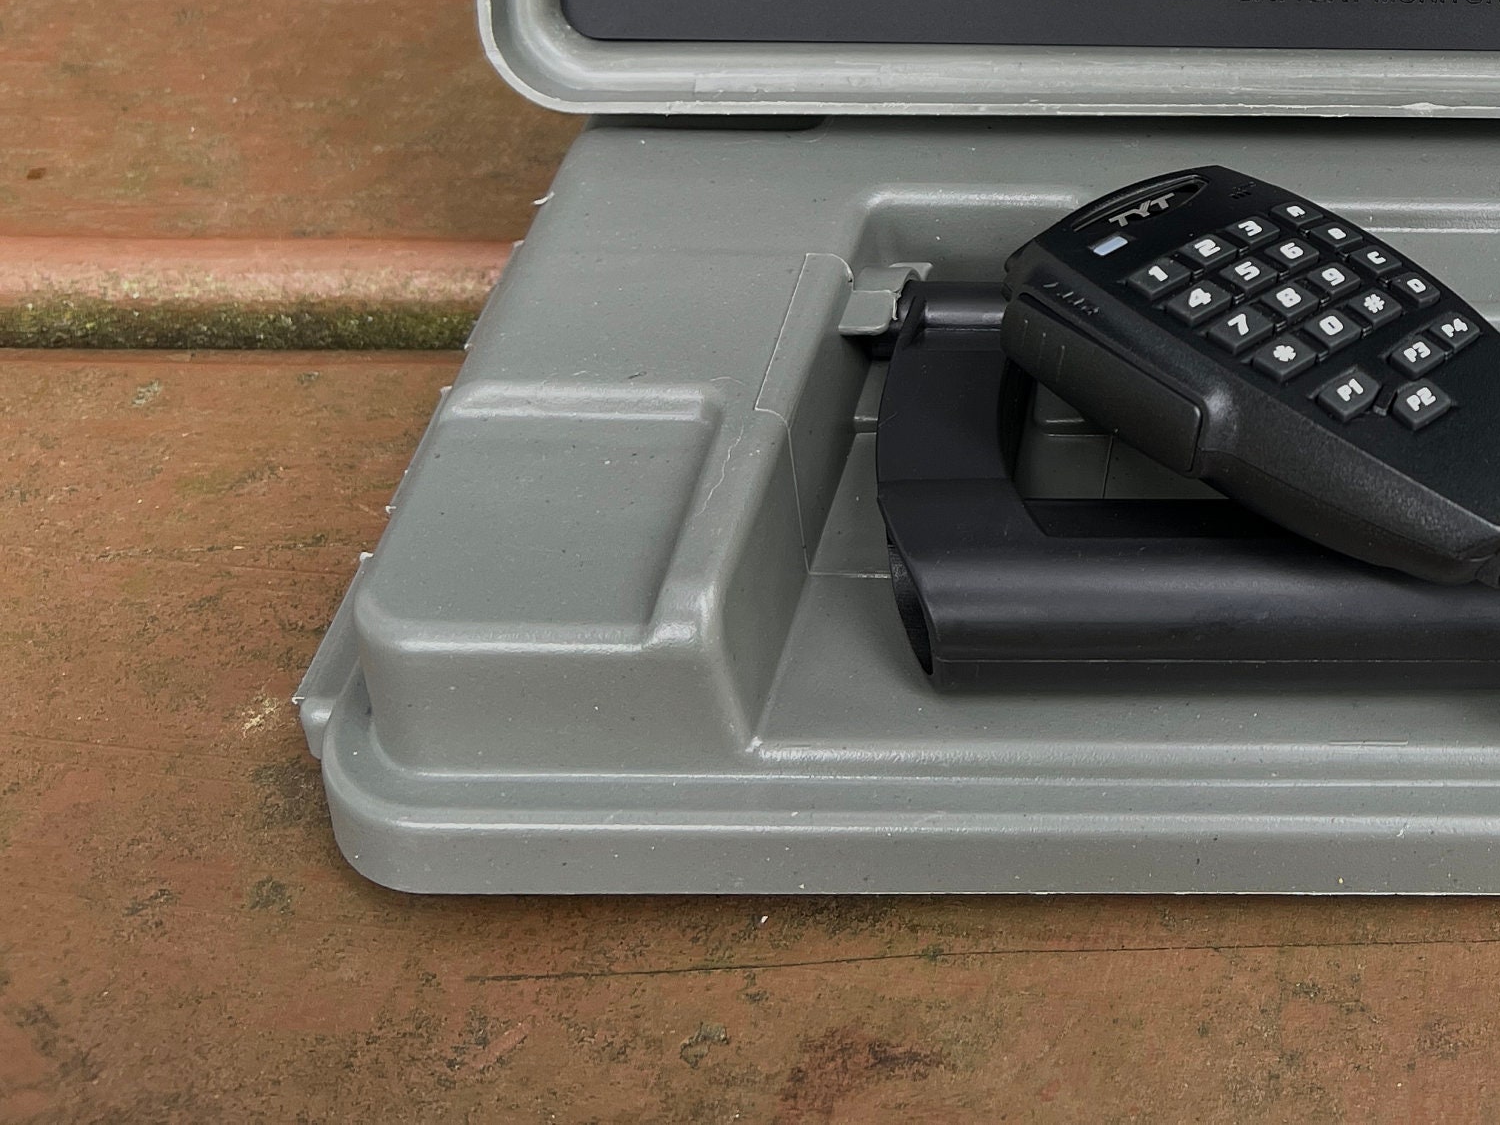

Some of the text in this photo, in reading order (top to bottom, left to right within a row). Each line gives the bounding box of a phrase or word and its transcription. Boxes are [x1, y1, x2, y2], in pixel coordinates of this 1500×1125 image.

[1108, 192, 1175, 227] TYT
[1148, 264, 1169, 282] 1
[1194, 238, 1221, 258] 2
[1238, 220, 1263, 237] 3
[1188, 287, 1212, 308] 4
[1234, 261, 1261, 281] 5
[1279, 242, 1304, 260] 6
[1227, 313, 1250, 336] 7
[1275, 287, 1302, 308] 8
[1321, 267, 1345, 286] 9
[1403, 317, 1468, 363] P3 P4
[1336, 378, 1437, 412] P1 P2
